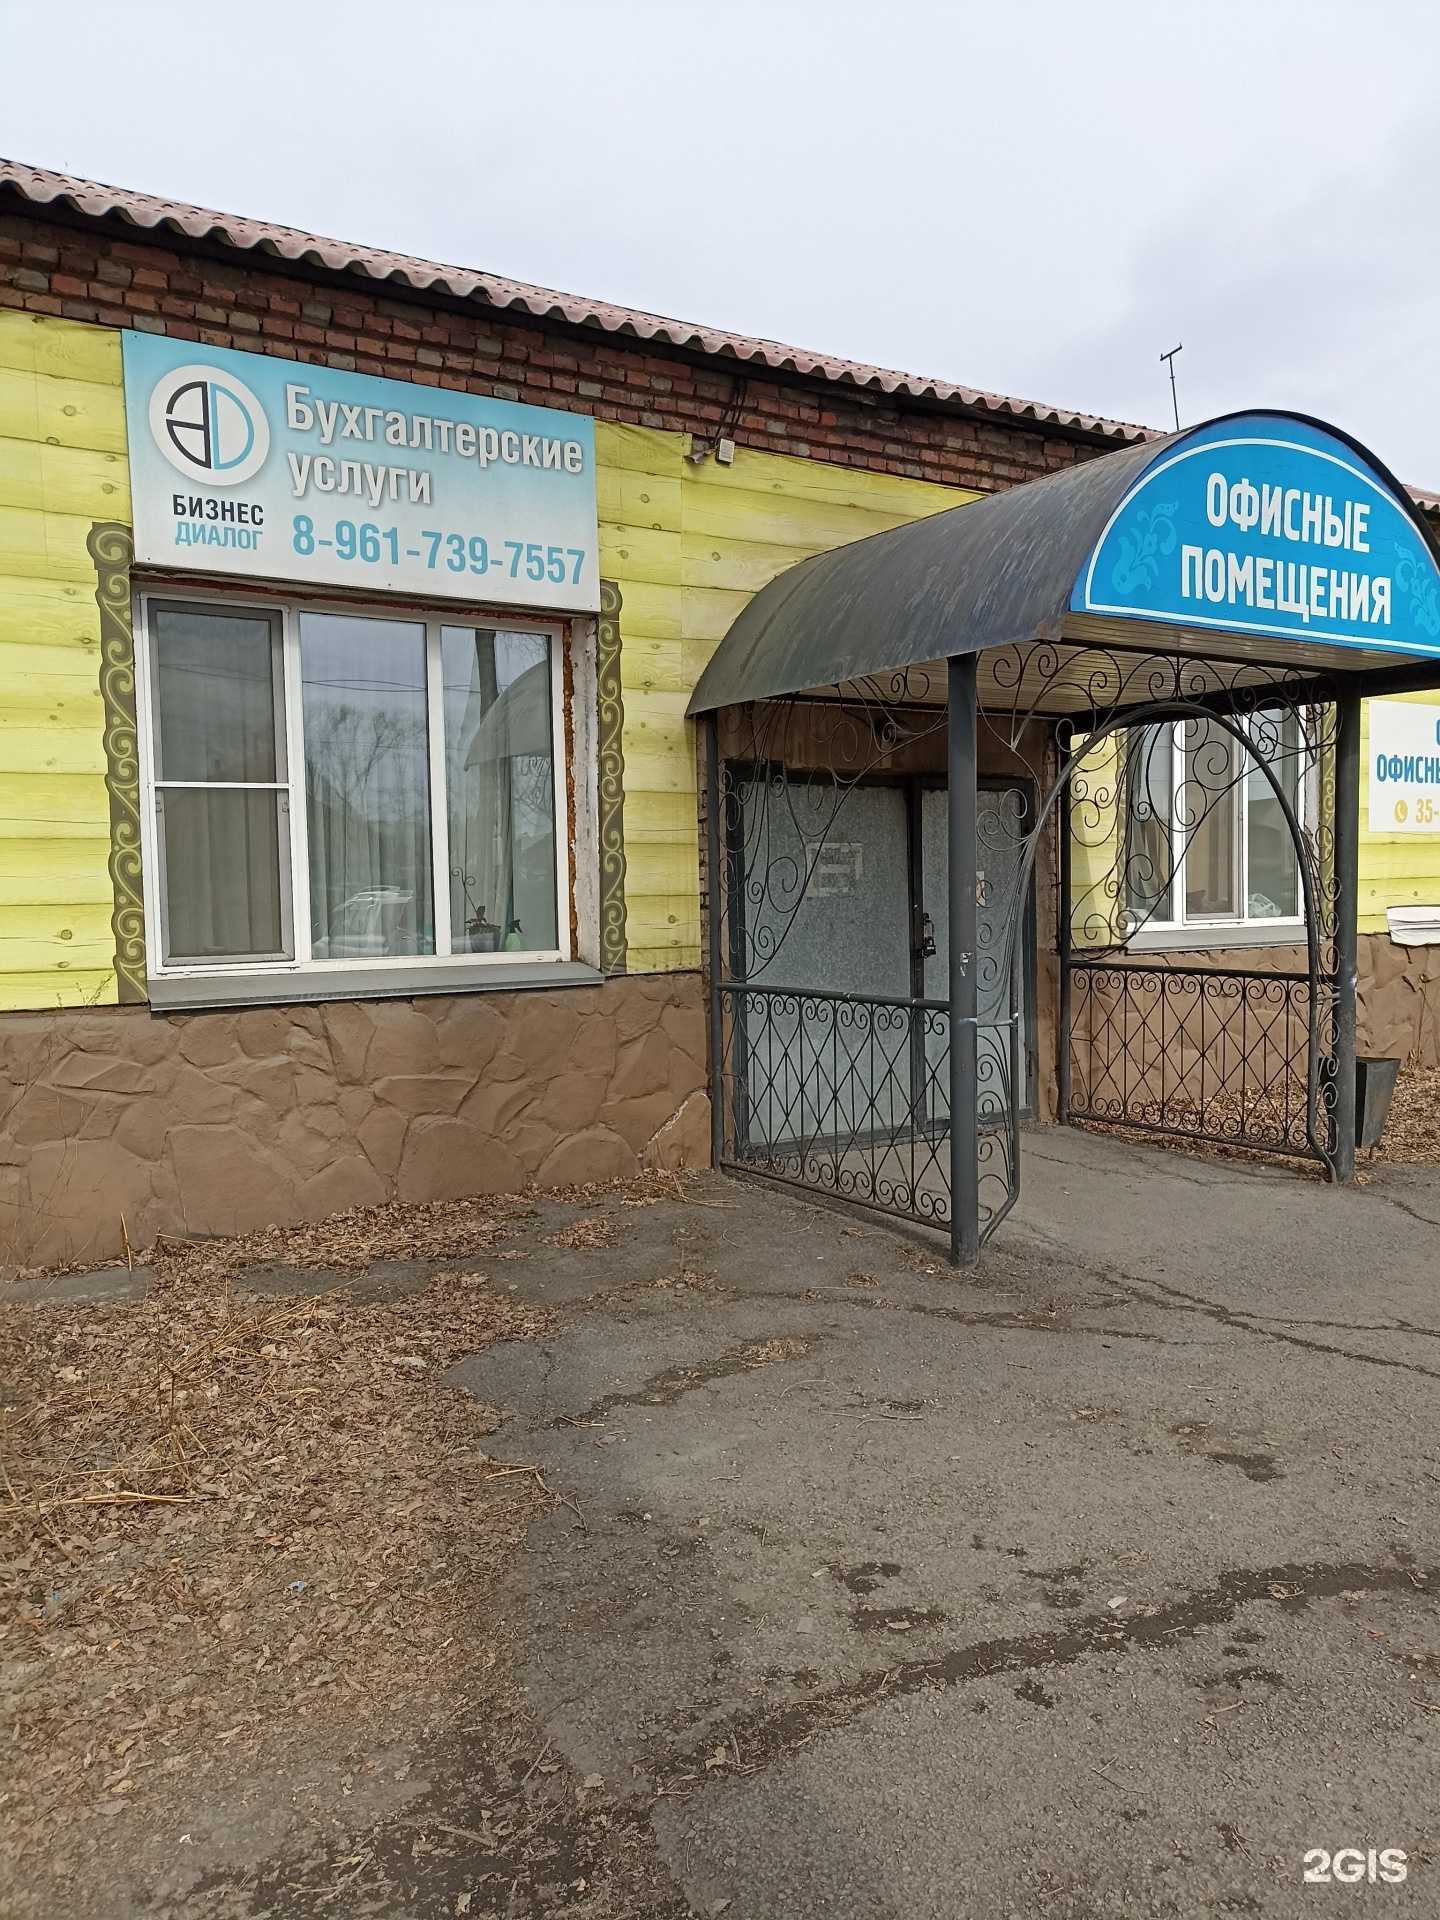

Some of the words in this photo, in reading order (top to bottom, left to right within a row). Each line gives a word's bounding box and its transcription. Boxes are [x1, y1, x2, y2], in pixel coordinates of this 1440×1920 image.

[286, 384, 584, 473] Бухгалтерские
[172, 494, 264, 526] БИЗНЕС
[287, 452, 432, 506] услуги
[1206, 472, 1370, 553] ОФИСНЫЕ
[174, 520, 264, 550] ДИАЛОГ
[293, 515, 586, 585] 8-961-739-7557
[1181, 544, 1392, 625] ПОМЕЩЕНИЯ
